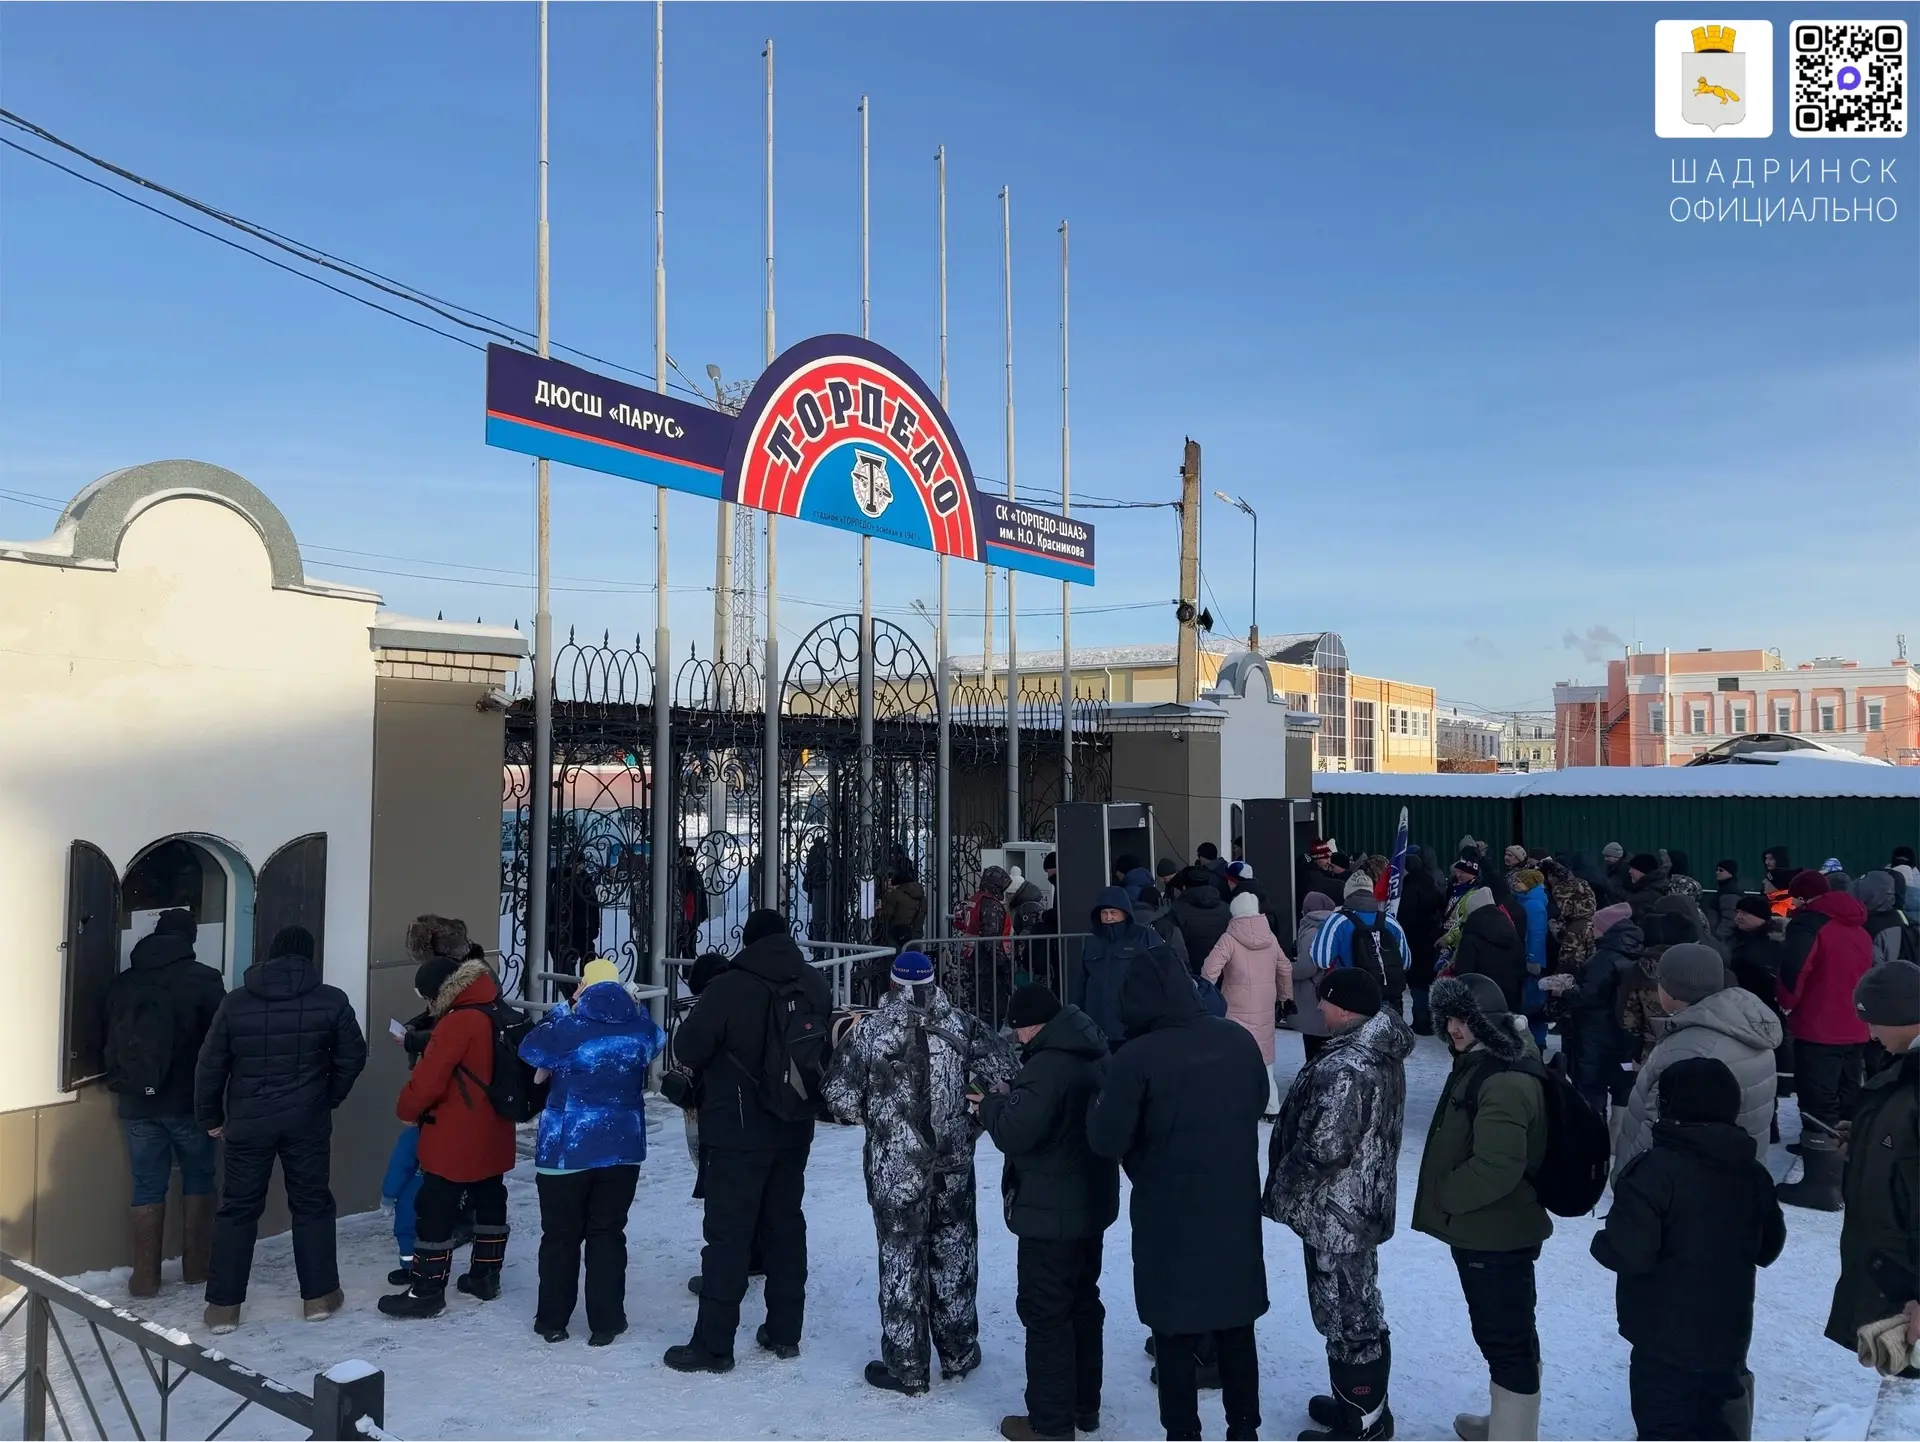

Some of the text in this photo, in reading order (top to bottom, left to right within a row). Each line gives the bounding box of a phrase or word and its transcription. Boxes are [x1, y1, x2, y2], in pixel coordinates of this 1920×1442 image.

[535, 380, 685, 438] ДЮСШ «ПАРУС»
[765, 378, 959, 515] ТОРПЕДО
[995, 504, 1088, 541] СК «ТОРПЕДО-ШААЗ»
[999, 527, 1085, 558] им. Н.О. Красникова
